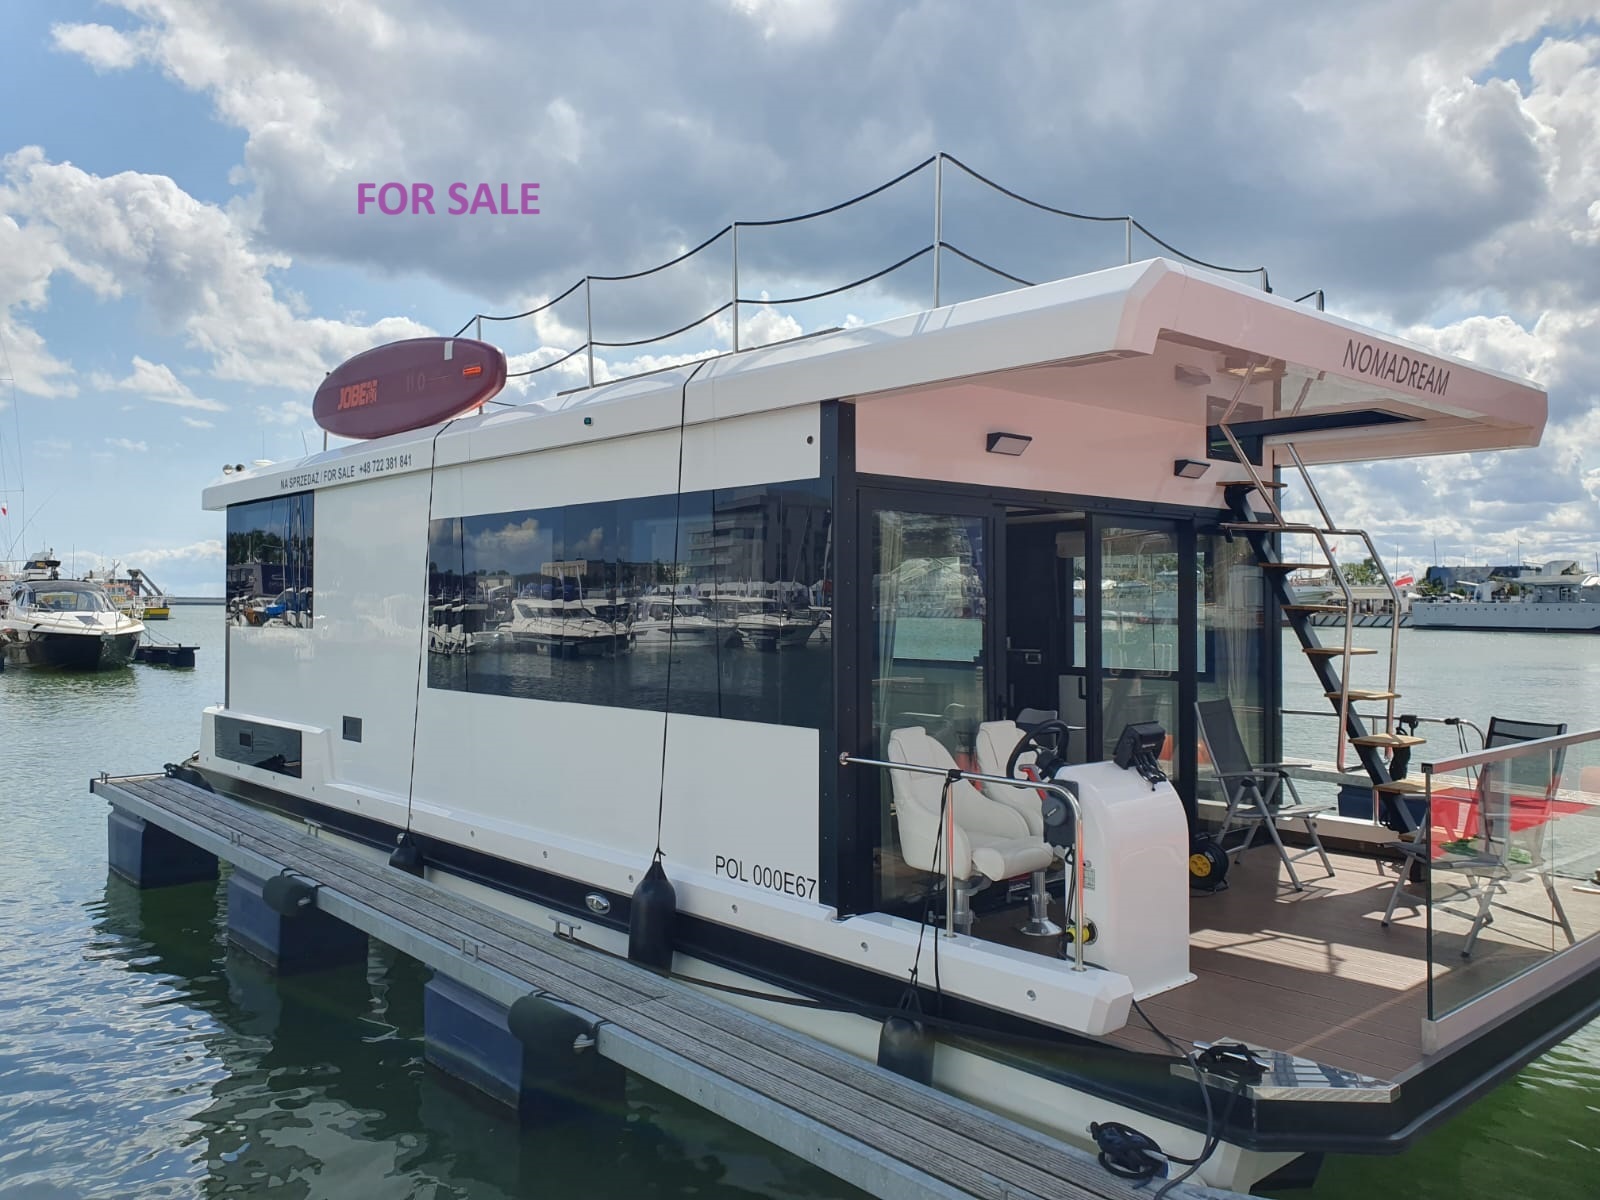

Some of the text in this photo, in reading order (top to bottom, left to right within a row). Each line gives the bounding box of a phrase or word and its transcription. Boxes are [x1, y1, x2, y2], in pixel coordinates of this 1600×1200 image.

[1342, 338, 1451, 397] NOMADREAM
[337, 382, 370, 410] JOBE
[280, 478, 289, 490] NA
[323, 468, 336, 481] FOR
[337, 465, 355, 479] SALE
[359, 460, 371, 474] +48
[372, 458, 385, 472] 722
[385, 456, 398, 470] 381
[399, 453, 413, 468] 841
[715, 855, 817, 900] POL 000E67
